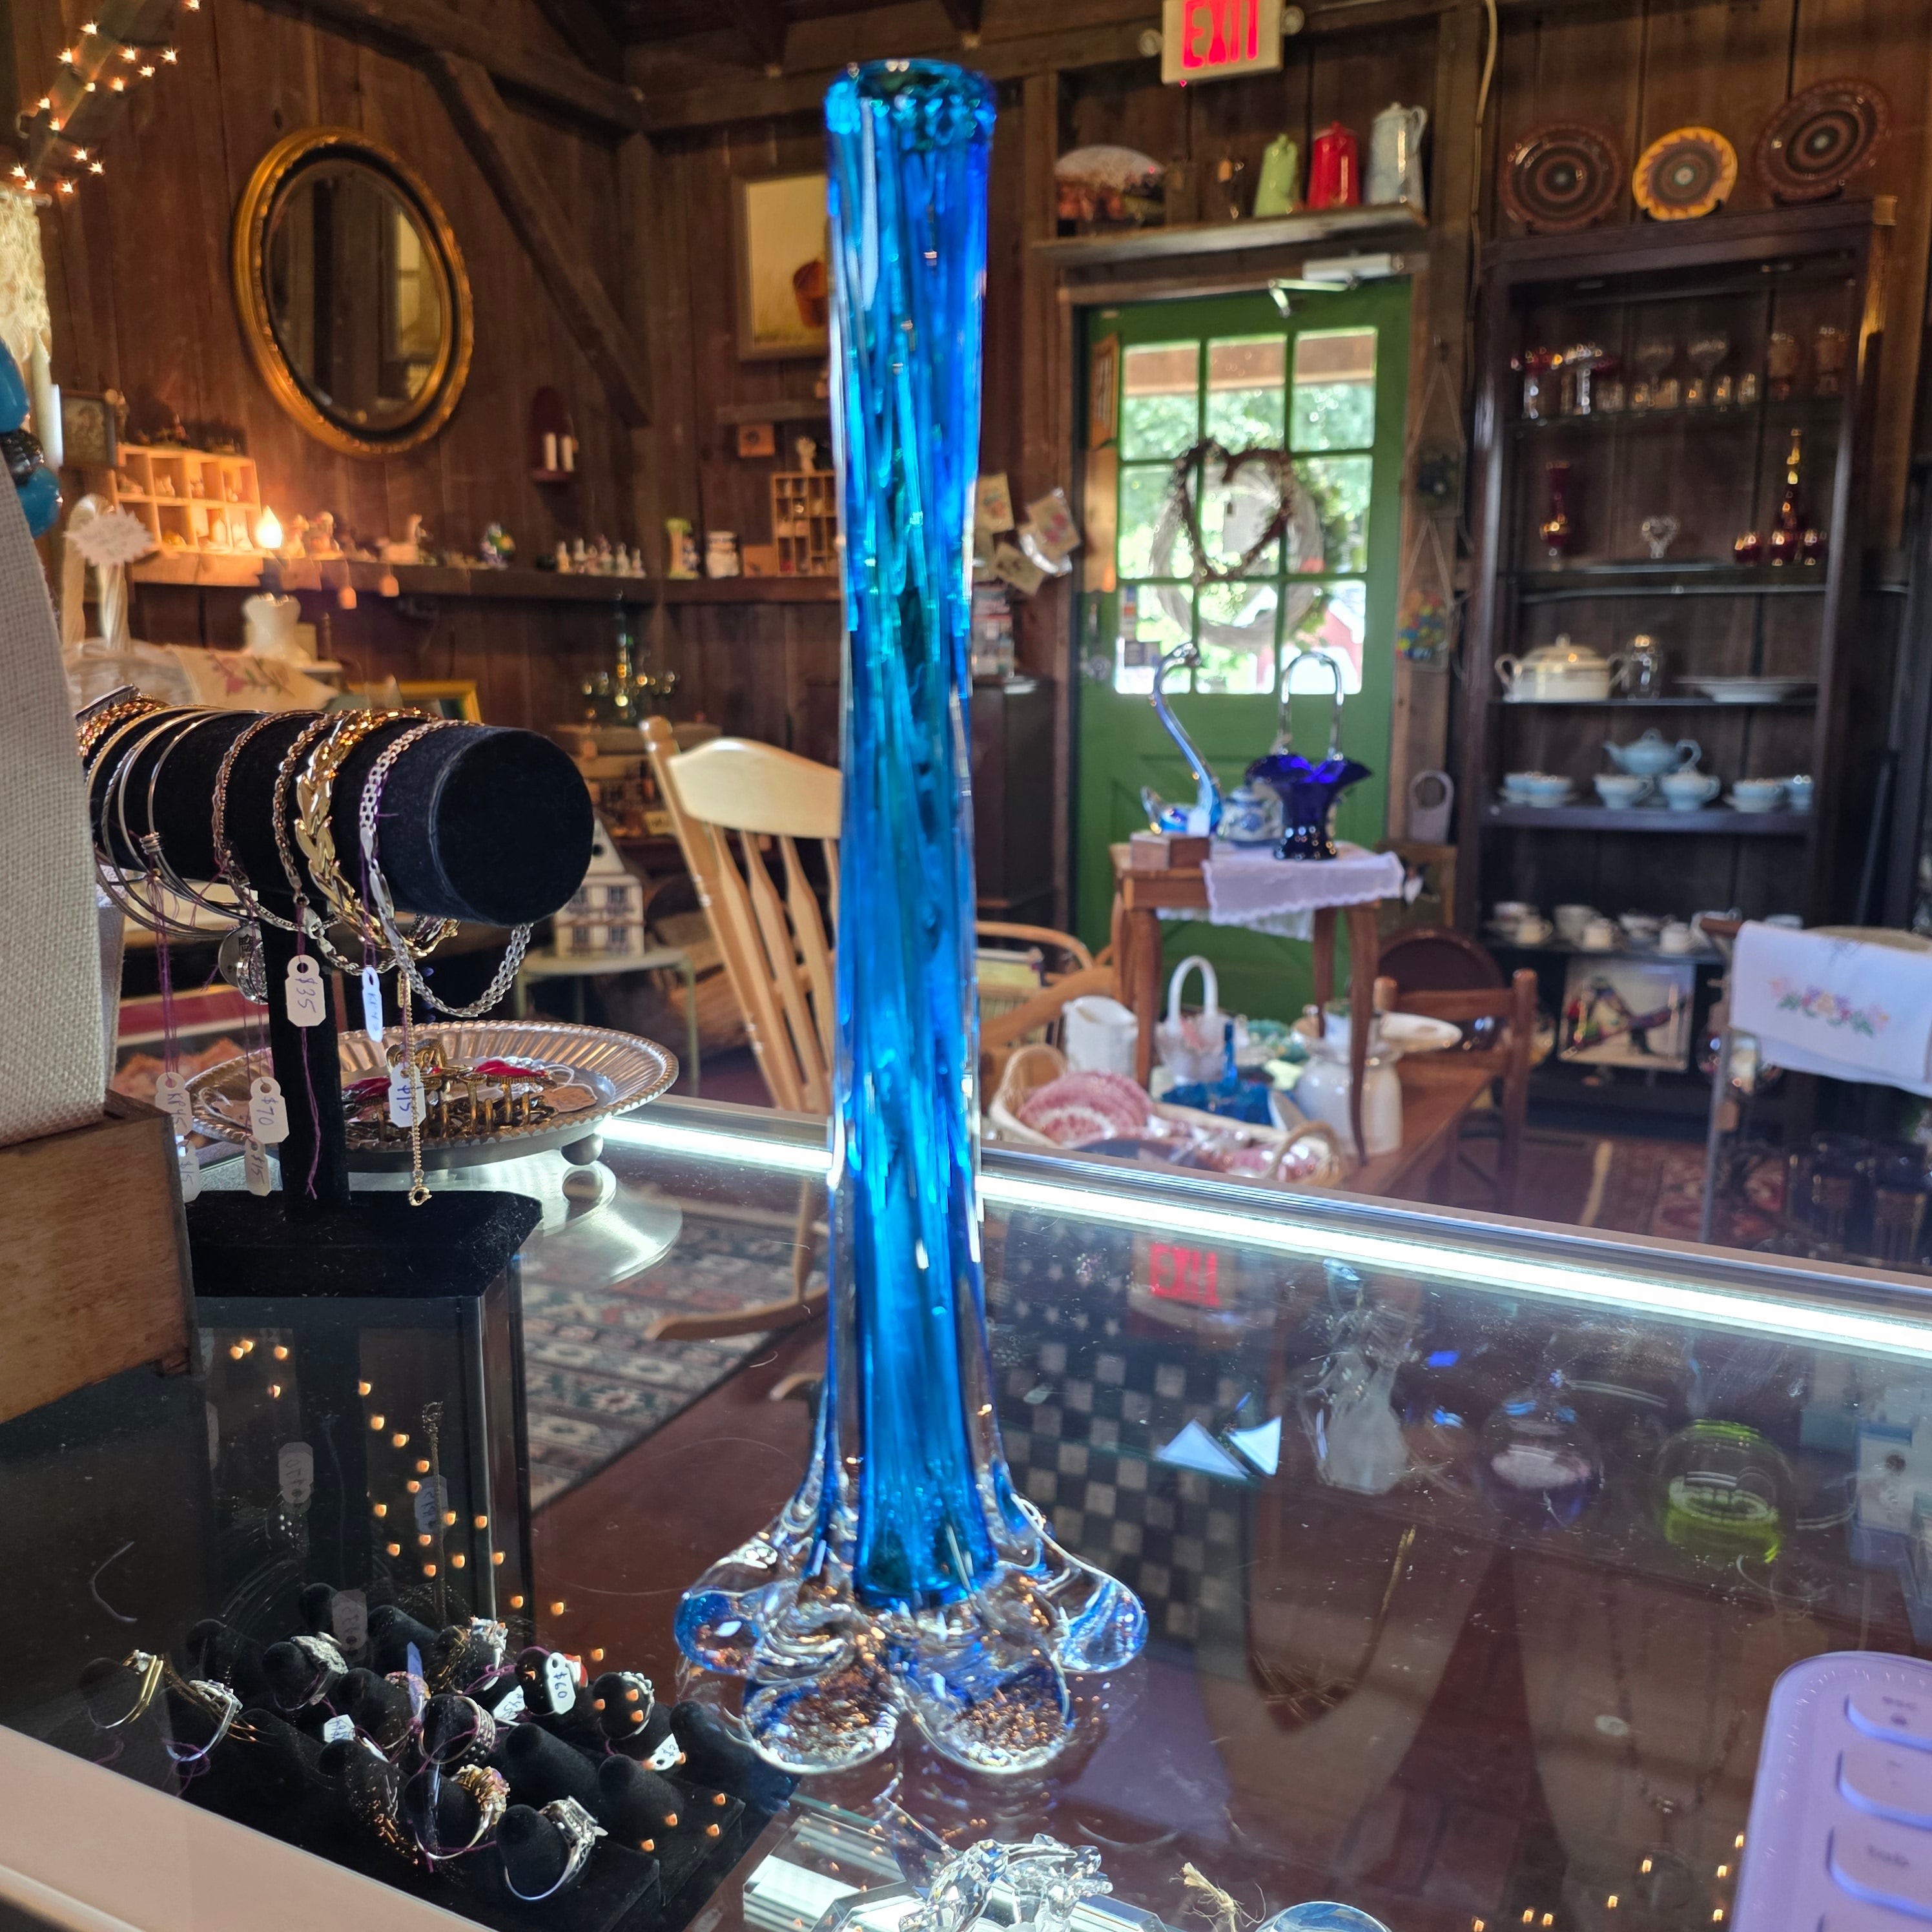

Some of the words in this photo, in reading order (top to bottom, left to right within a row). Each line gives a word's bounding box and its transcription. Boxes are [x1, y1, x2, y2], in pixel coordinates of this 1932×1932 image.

[294, 977, 318, 1013] $35
[256, 1096, 278, 1126] $70
[250, 1154, 266, 1184] $15
[553, 1671, 568, 1699] $60
